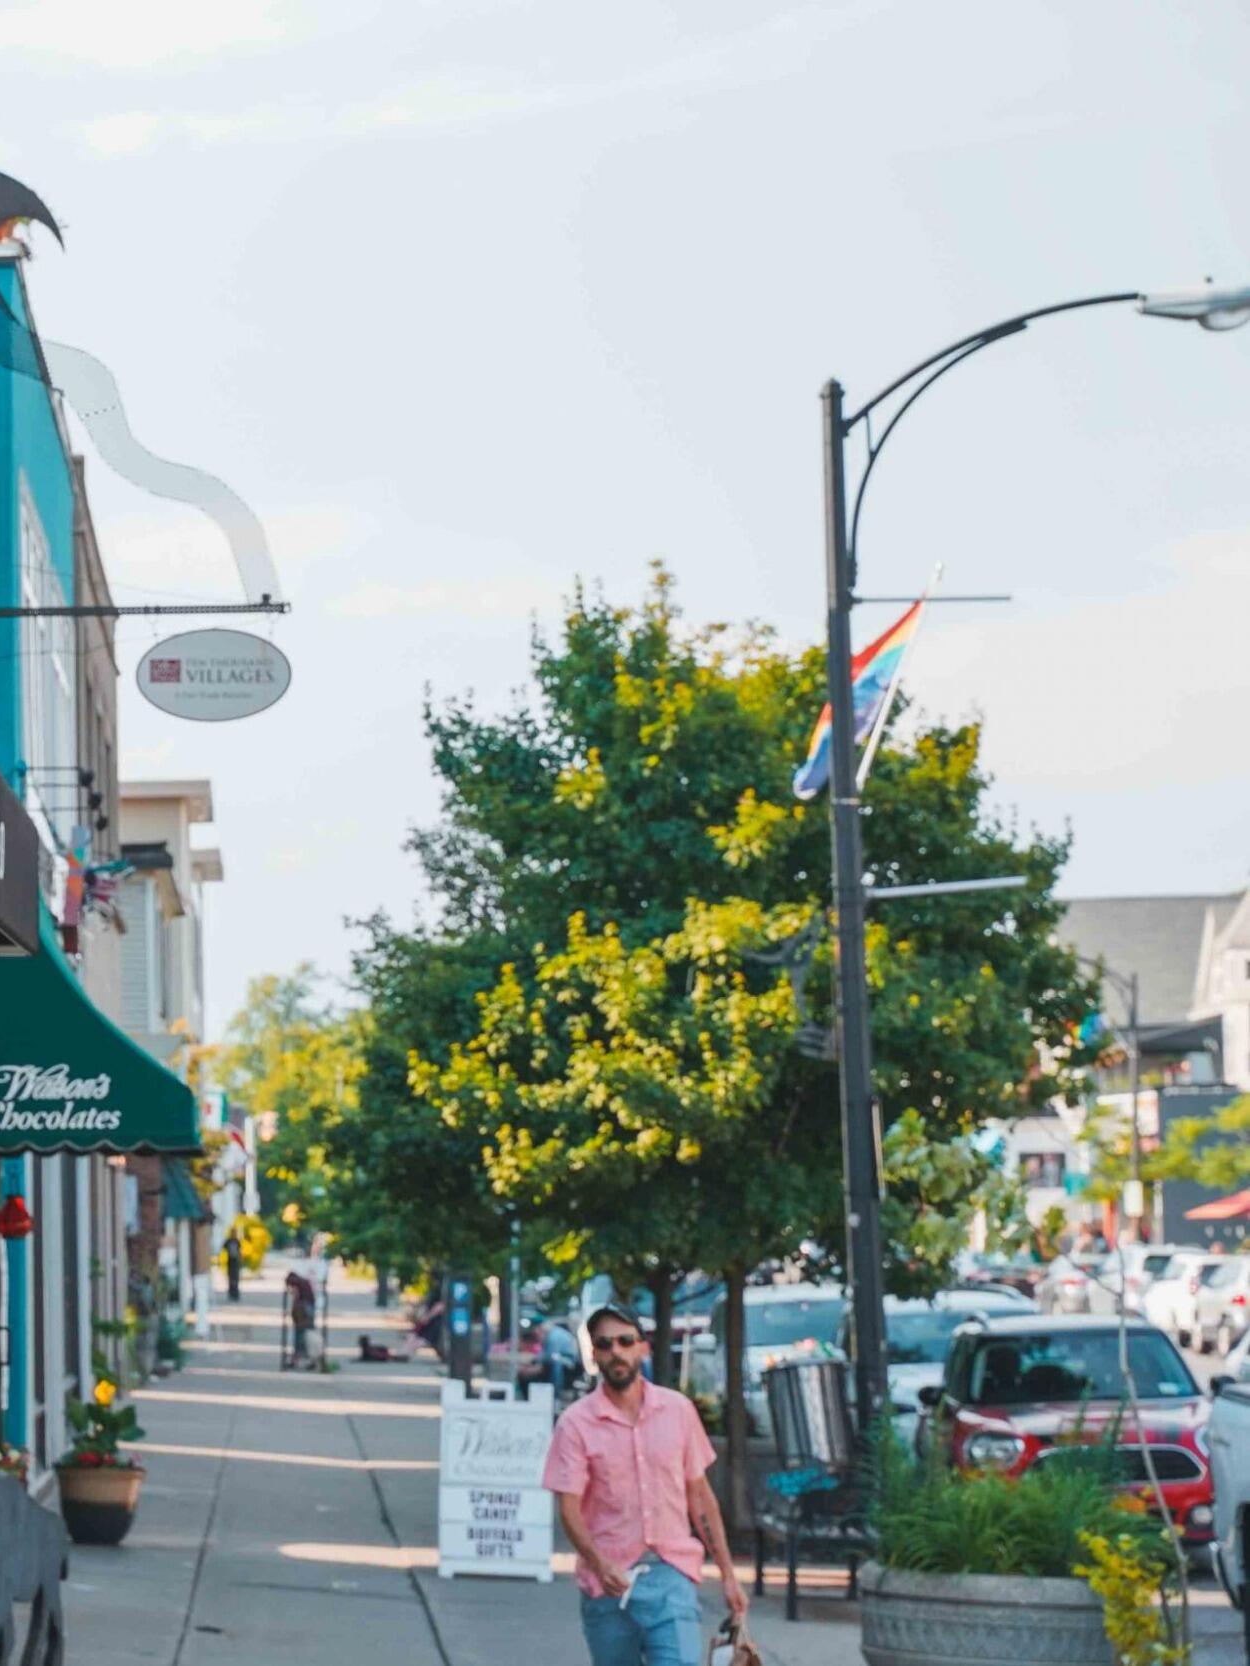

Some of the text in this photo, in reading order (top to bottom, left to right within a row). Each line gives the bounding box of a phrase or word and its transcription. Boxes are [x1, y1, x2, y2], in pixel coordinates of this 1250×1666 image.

[185, 668, 275, 684] VILLAGES
[469, 1490, 521, 1505] SPONGE
[473, 1507, 518, 1520] CANDY
[467, 1526, 524, 1542] BUFFALO
[476, 1543, 515, 1558] GIFTS
